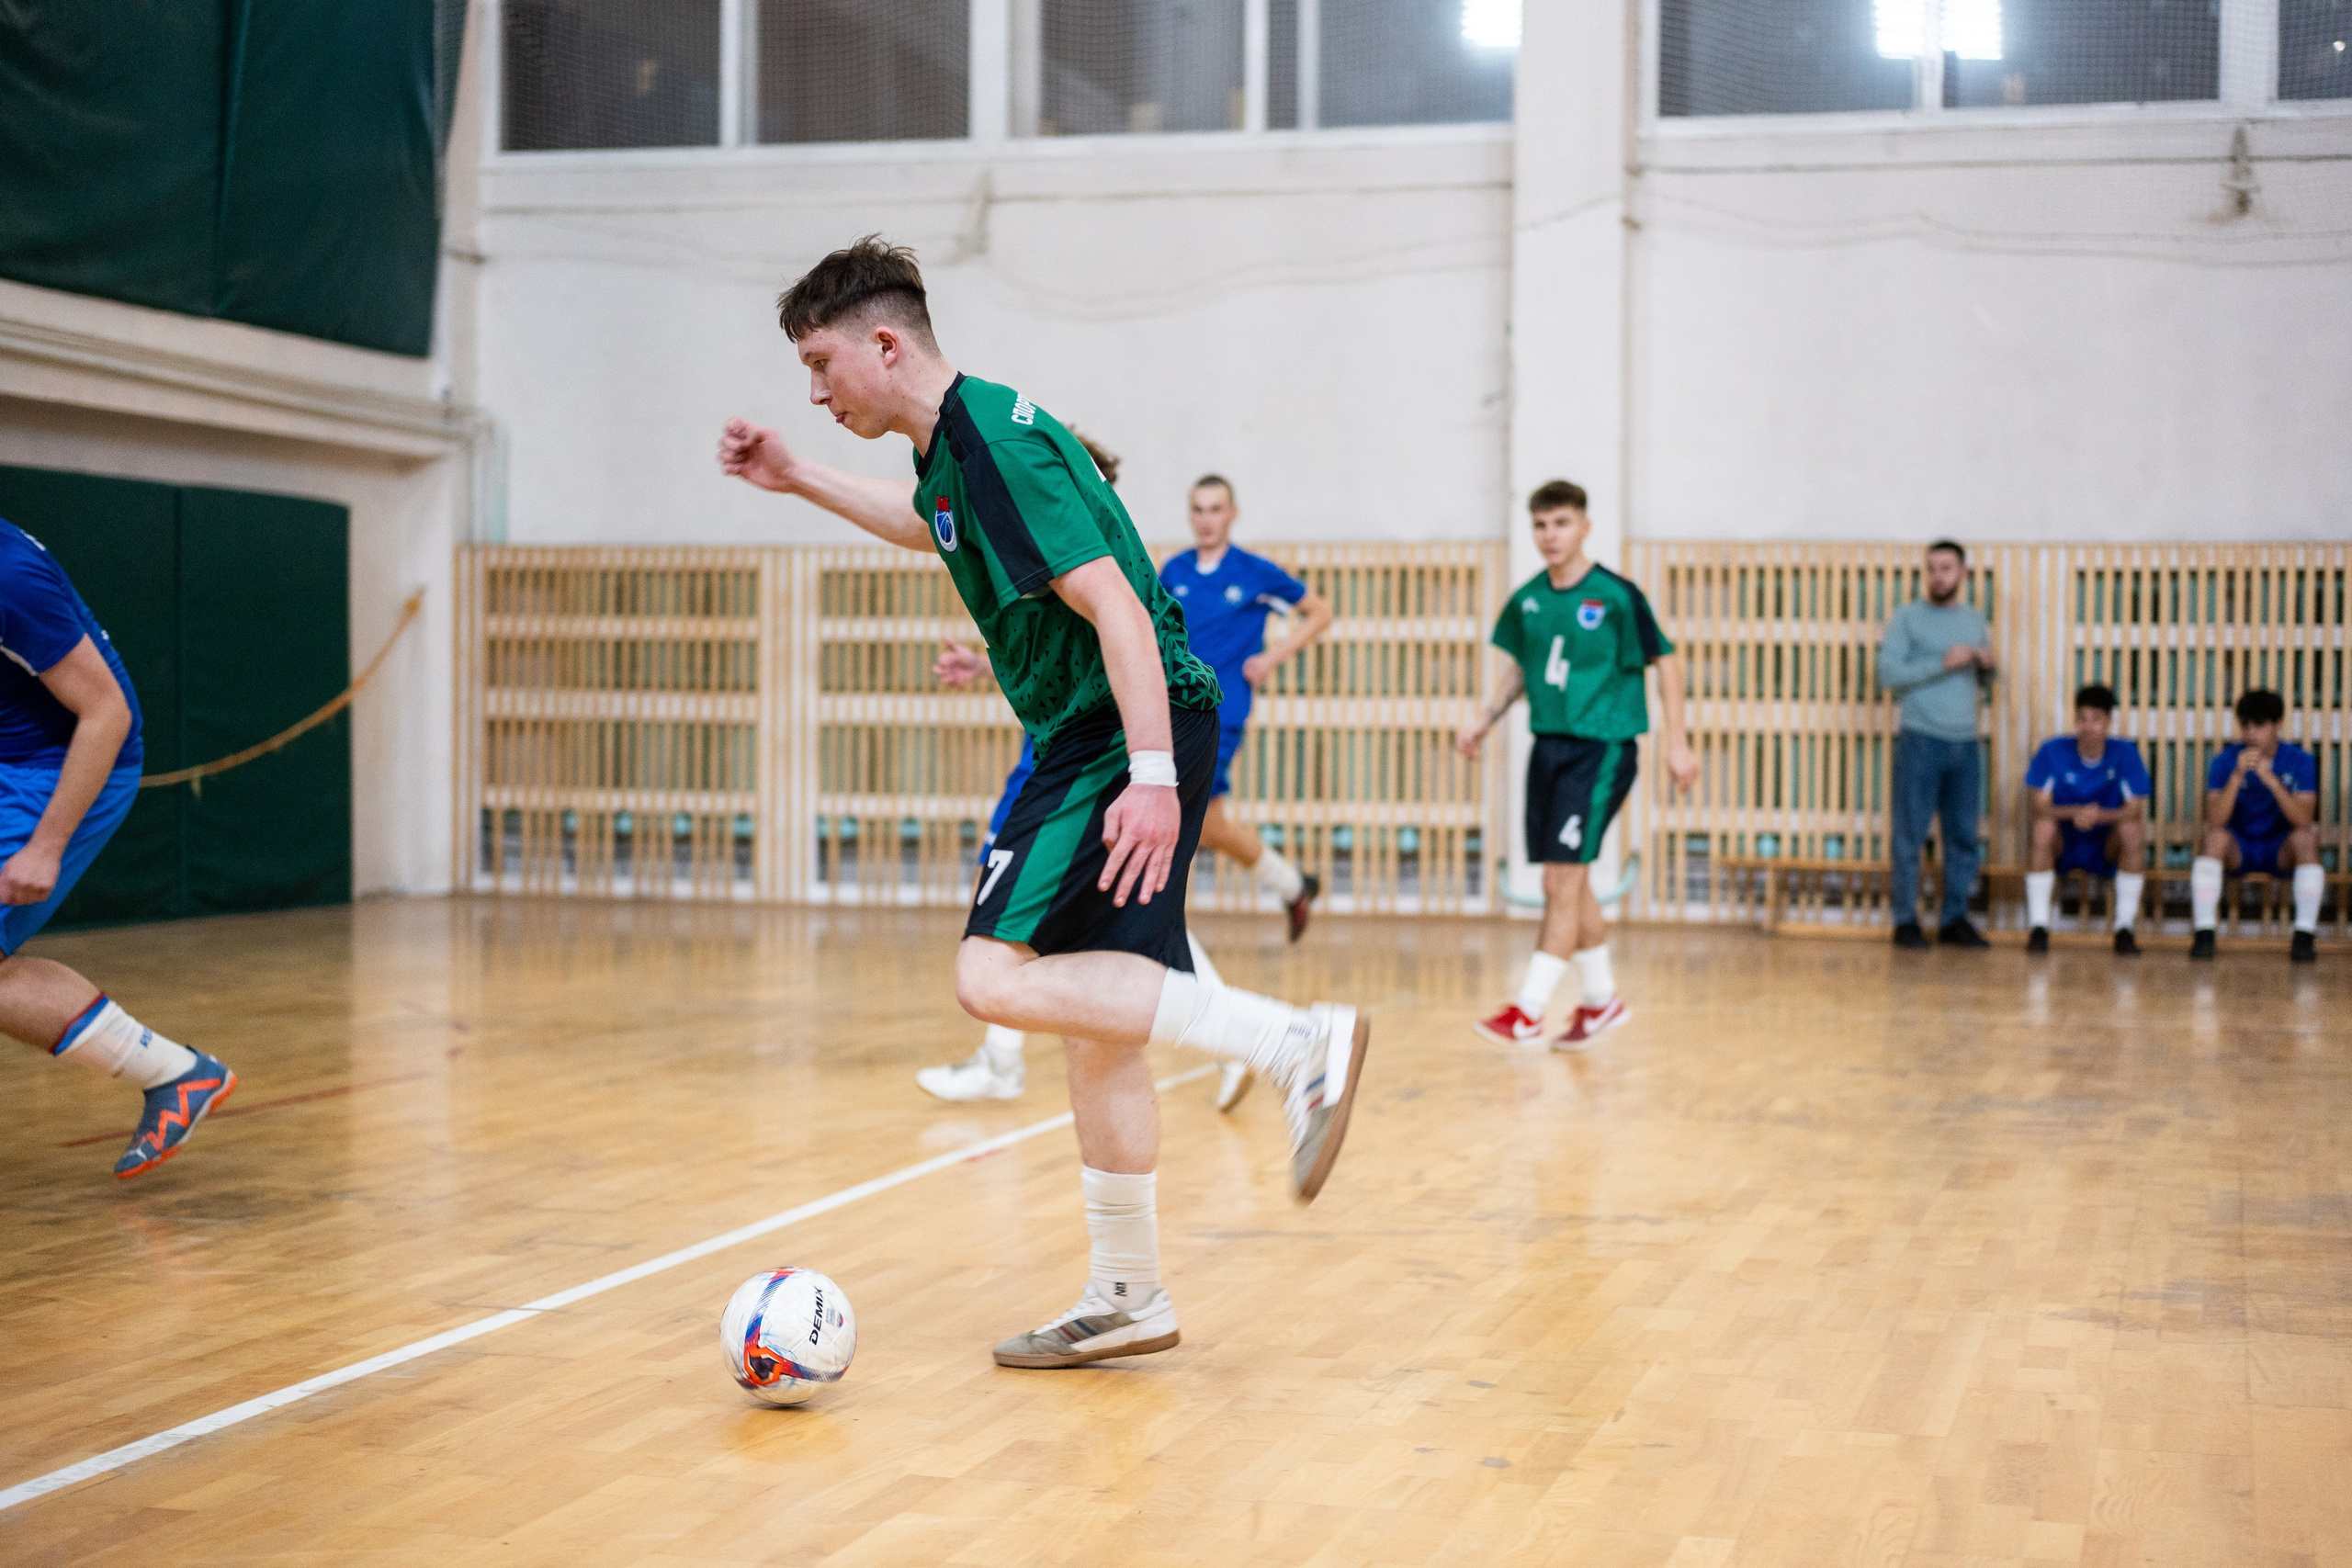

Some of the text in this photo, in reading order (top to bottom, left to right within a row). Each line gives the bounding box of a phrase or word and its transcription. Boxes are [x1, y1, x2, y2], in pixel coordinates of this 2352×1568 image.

[1544, 635, 1569, 692] 4
[1558, 814, 1581, 850] 4
[977, 849, 1014, 907] 7
[809, 1285, 823, 1345] DEMIX
